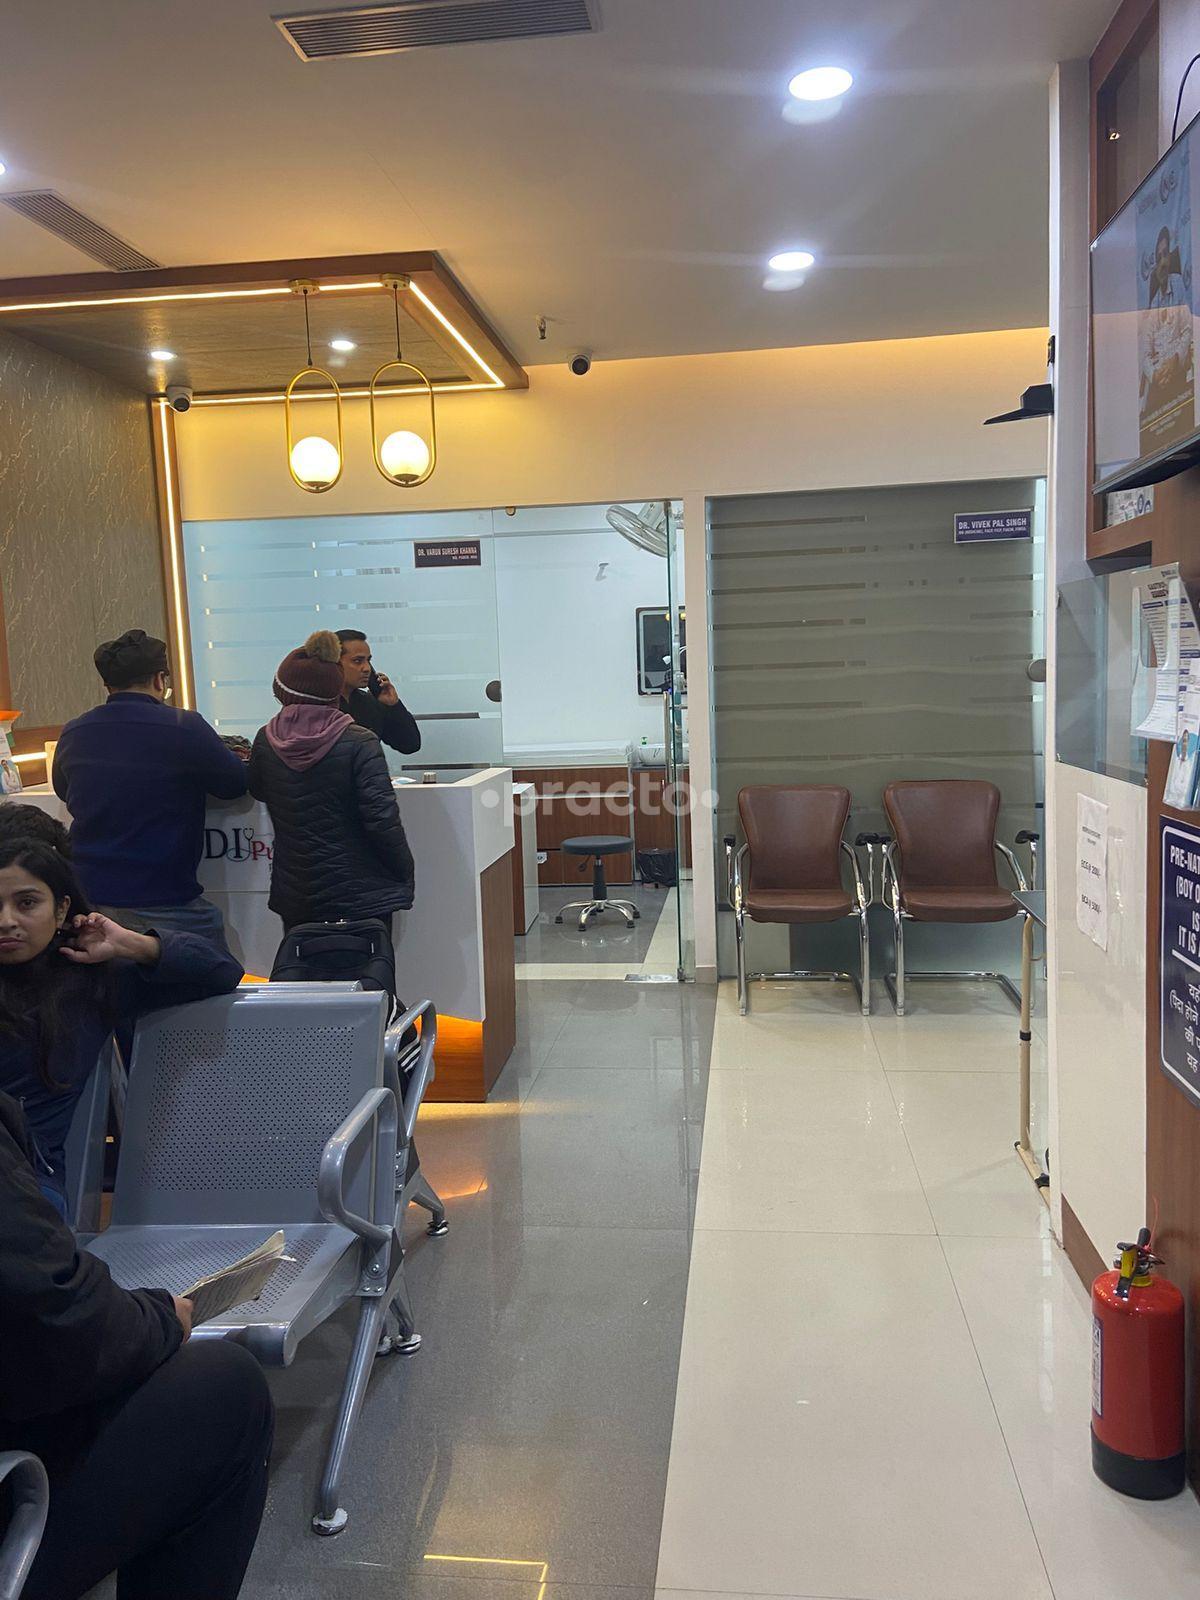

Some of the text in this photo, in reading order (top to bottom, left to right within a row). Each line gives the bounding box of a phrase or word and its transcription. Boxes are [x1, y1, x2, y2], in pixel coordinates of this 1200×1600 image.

[958, 517, 1027, 530] DR. VIVEK PAL SINGH
[1176, 875, 1193, 900] (BOY
[1178, 925, 1196, 954] IT IS
